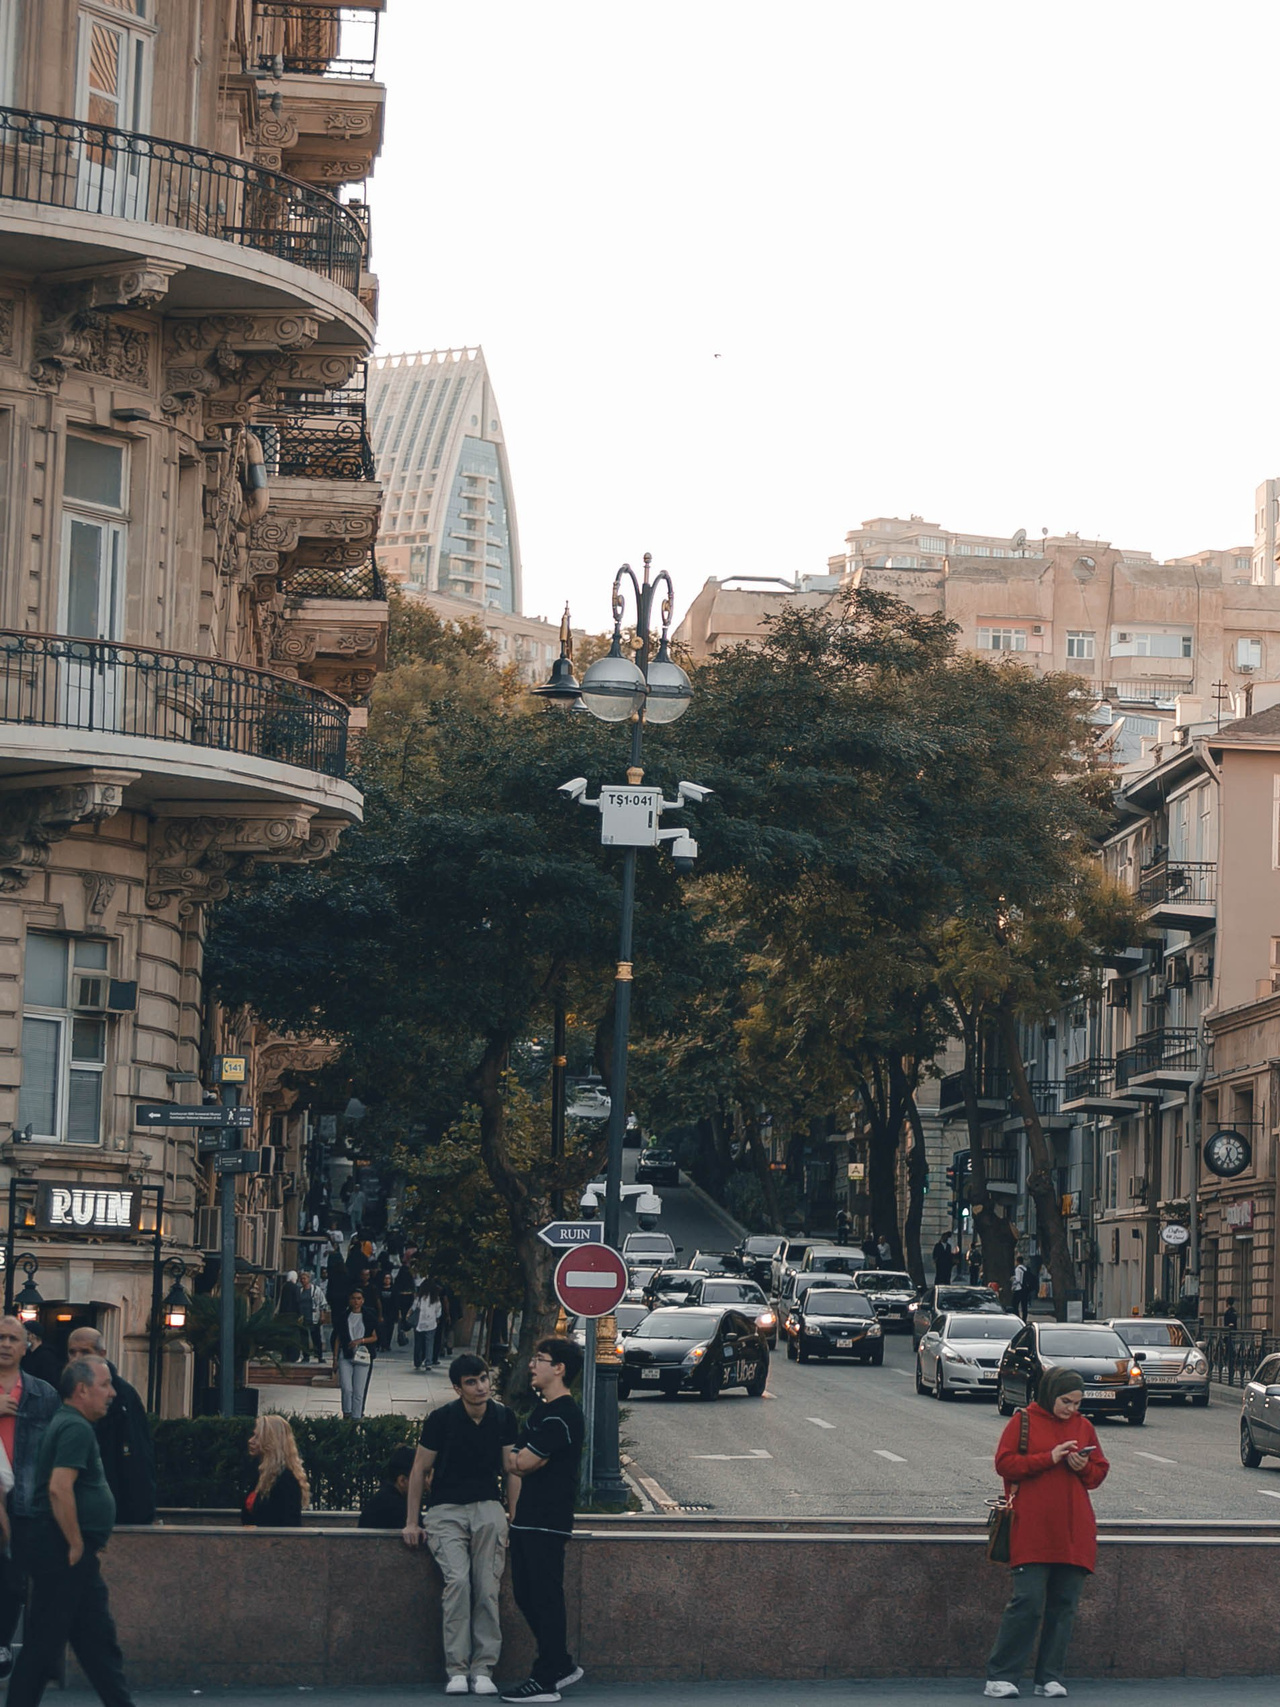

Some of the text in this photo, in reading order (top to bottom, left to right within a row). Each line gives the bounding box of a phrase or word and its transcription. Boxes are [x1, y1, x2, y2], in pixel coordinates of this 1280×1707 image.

[228, 1063, 242, 1072] 141
[50, 1188, 133, 1227] RUIN
[560, 1229, 591, 1239] RUIN
[736, 1359, 758, 1382] Uber
